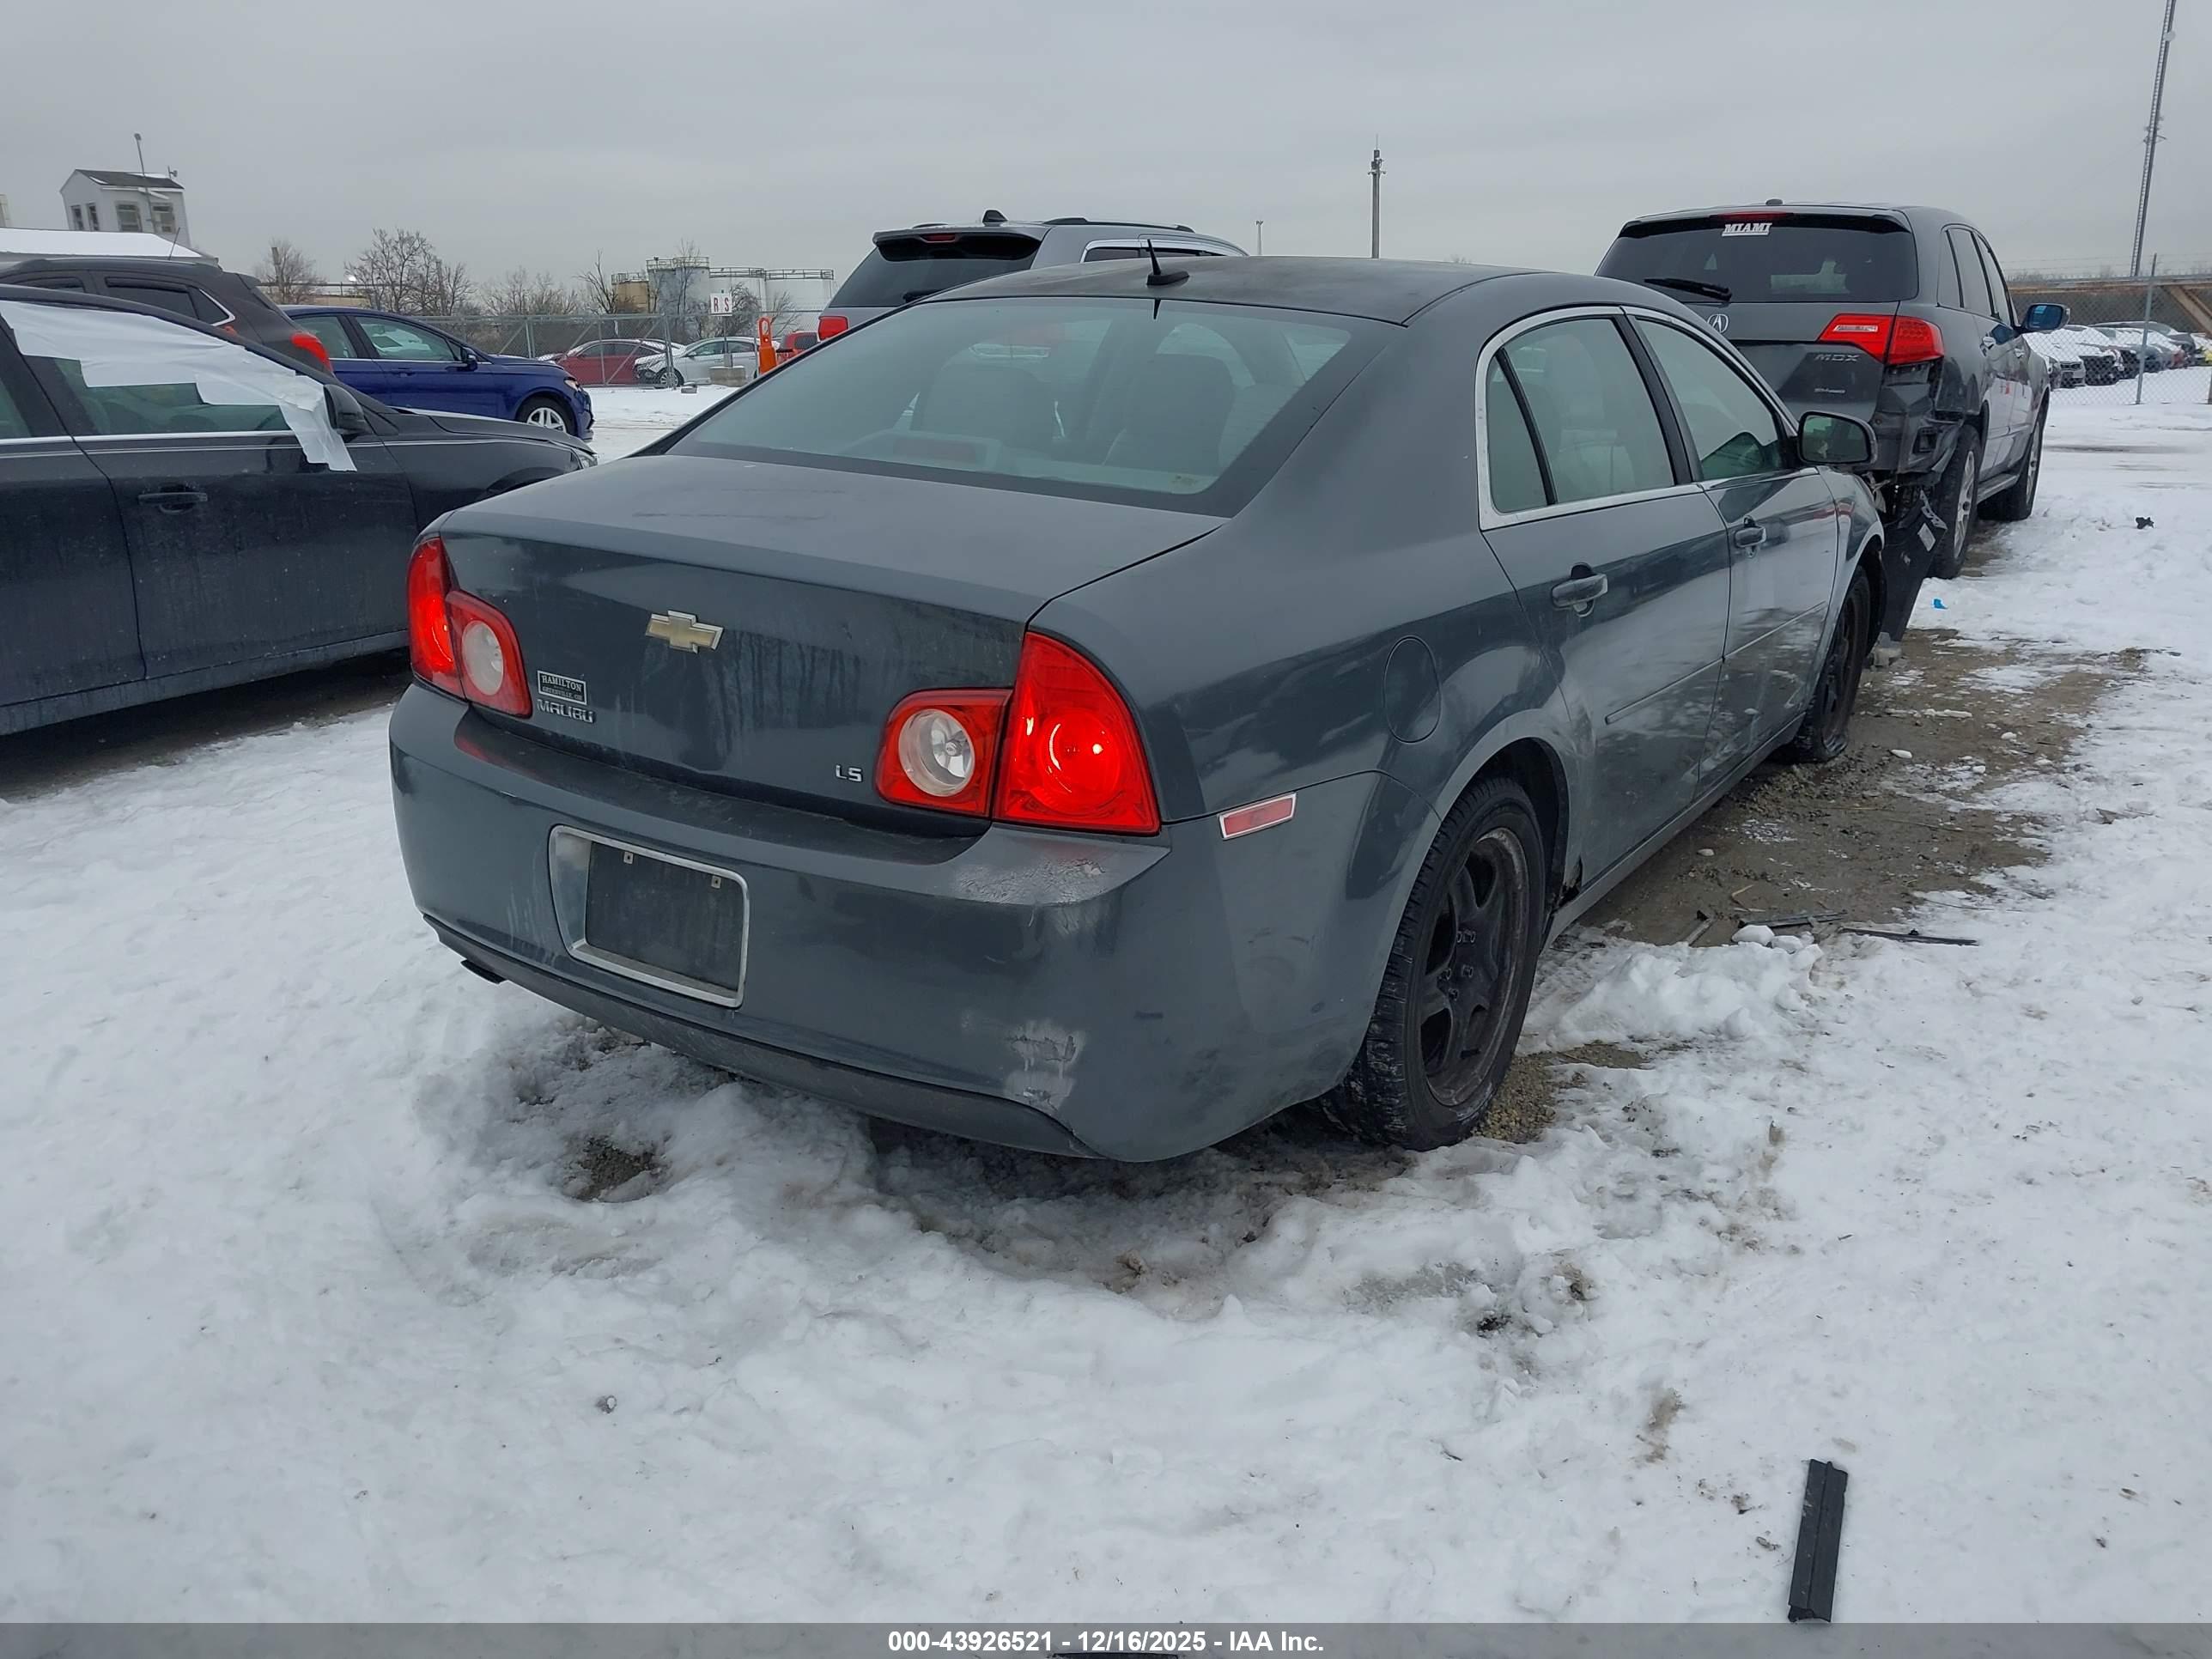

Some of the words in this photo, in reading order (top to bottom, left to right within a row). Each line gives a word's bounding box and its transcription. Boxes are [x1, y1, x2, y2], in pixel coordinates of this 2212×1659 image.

[1723, 222, 1772, 233] MIAMI
[714, 297, 719, 312] R
[725, 297, 729, 312] S
[541, 675, 582, 692] HAMILTON
[537, 698, 593, 723] MALIBU
[836, 764, 862, 782] LS
